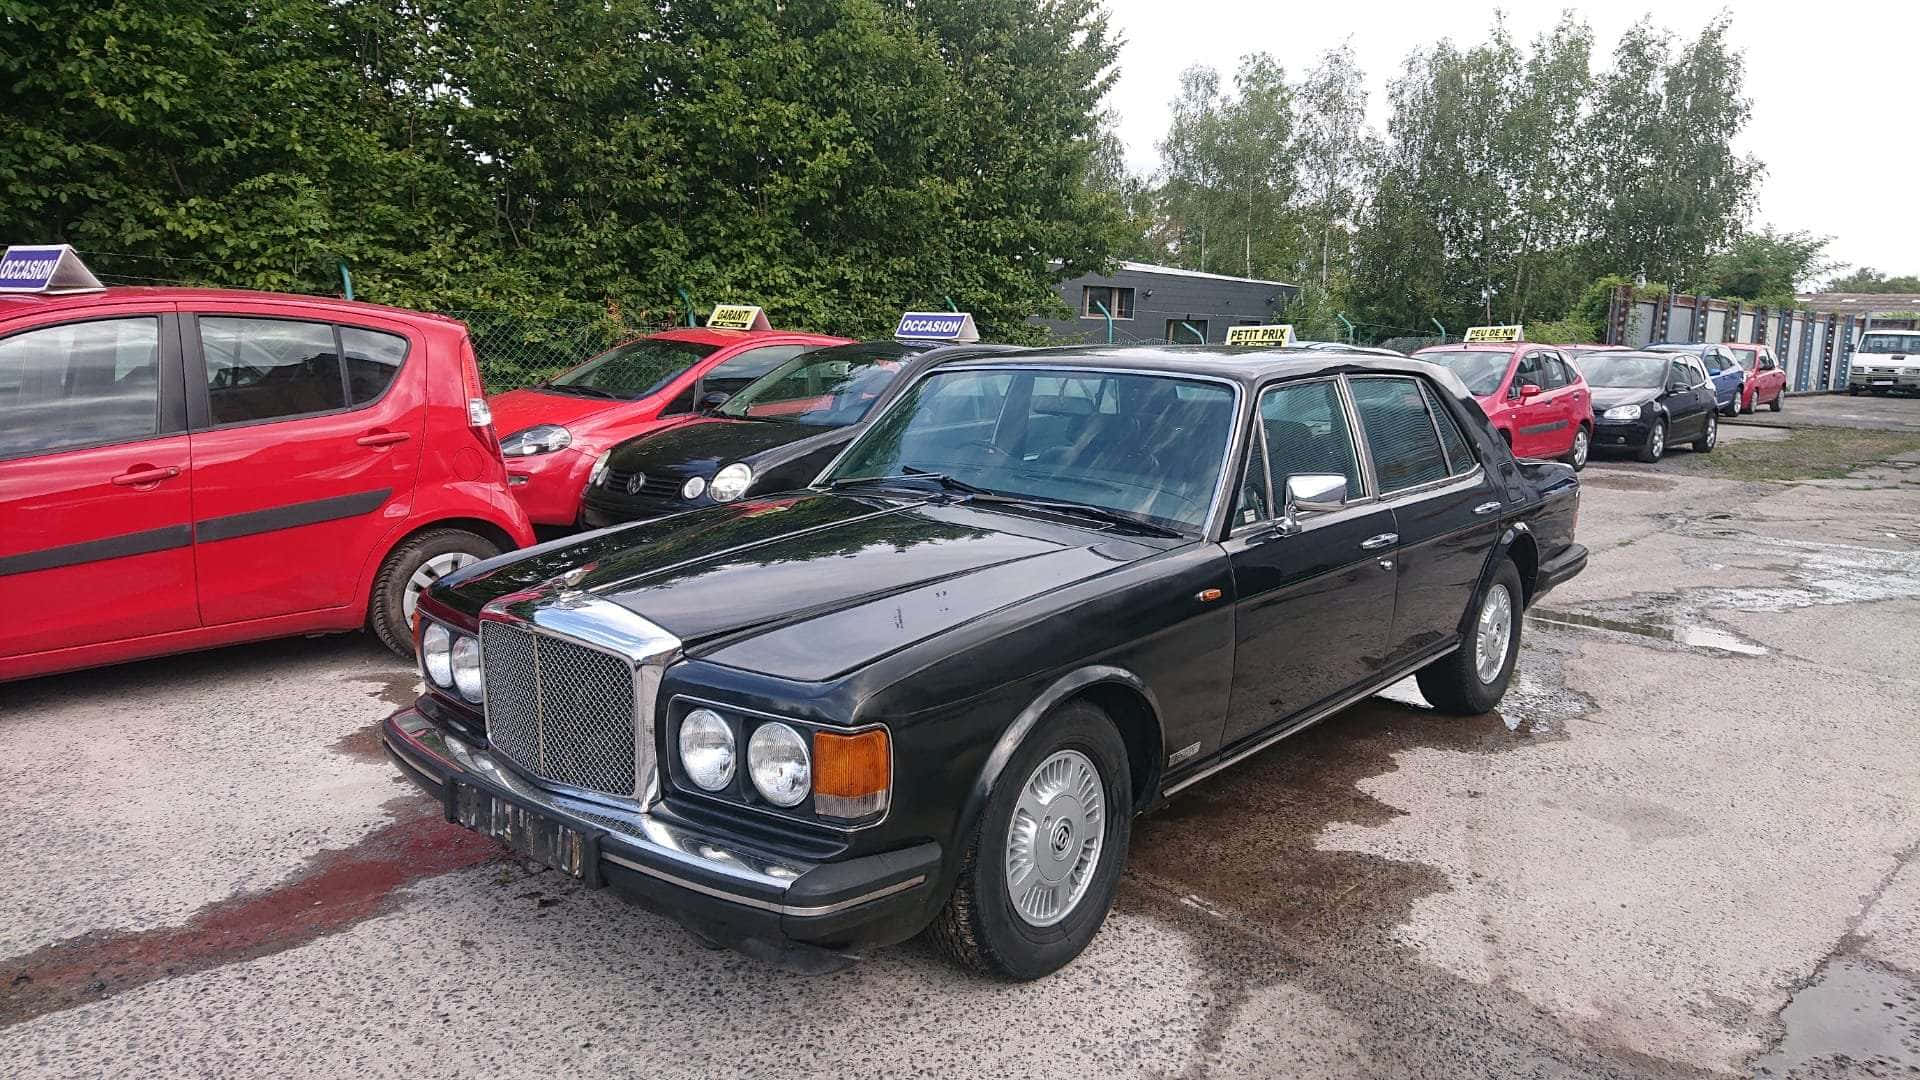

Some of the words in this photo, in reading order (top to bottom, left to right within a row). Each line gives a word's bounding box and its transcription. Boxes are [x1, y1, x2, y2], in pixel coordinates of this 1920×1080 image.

[0, 259, 57, 280] OCCASION
[902, 319, 961, 333] OCCASION
[1470, 329, 1488, 337] PEU
[1488, 328, 1502, 337] DE
[1502, 327, 1517, 337] KM
[1230, 329, 1260, 341] PETIT
[1261, 328, 1286, 340] PRIX
